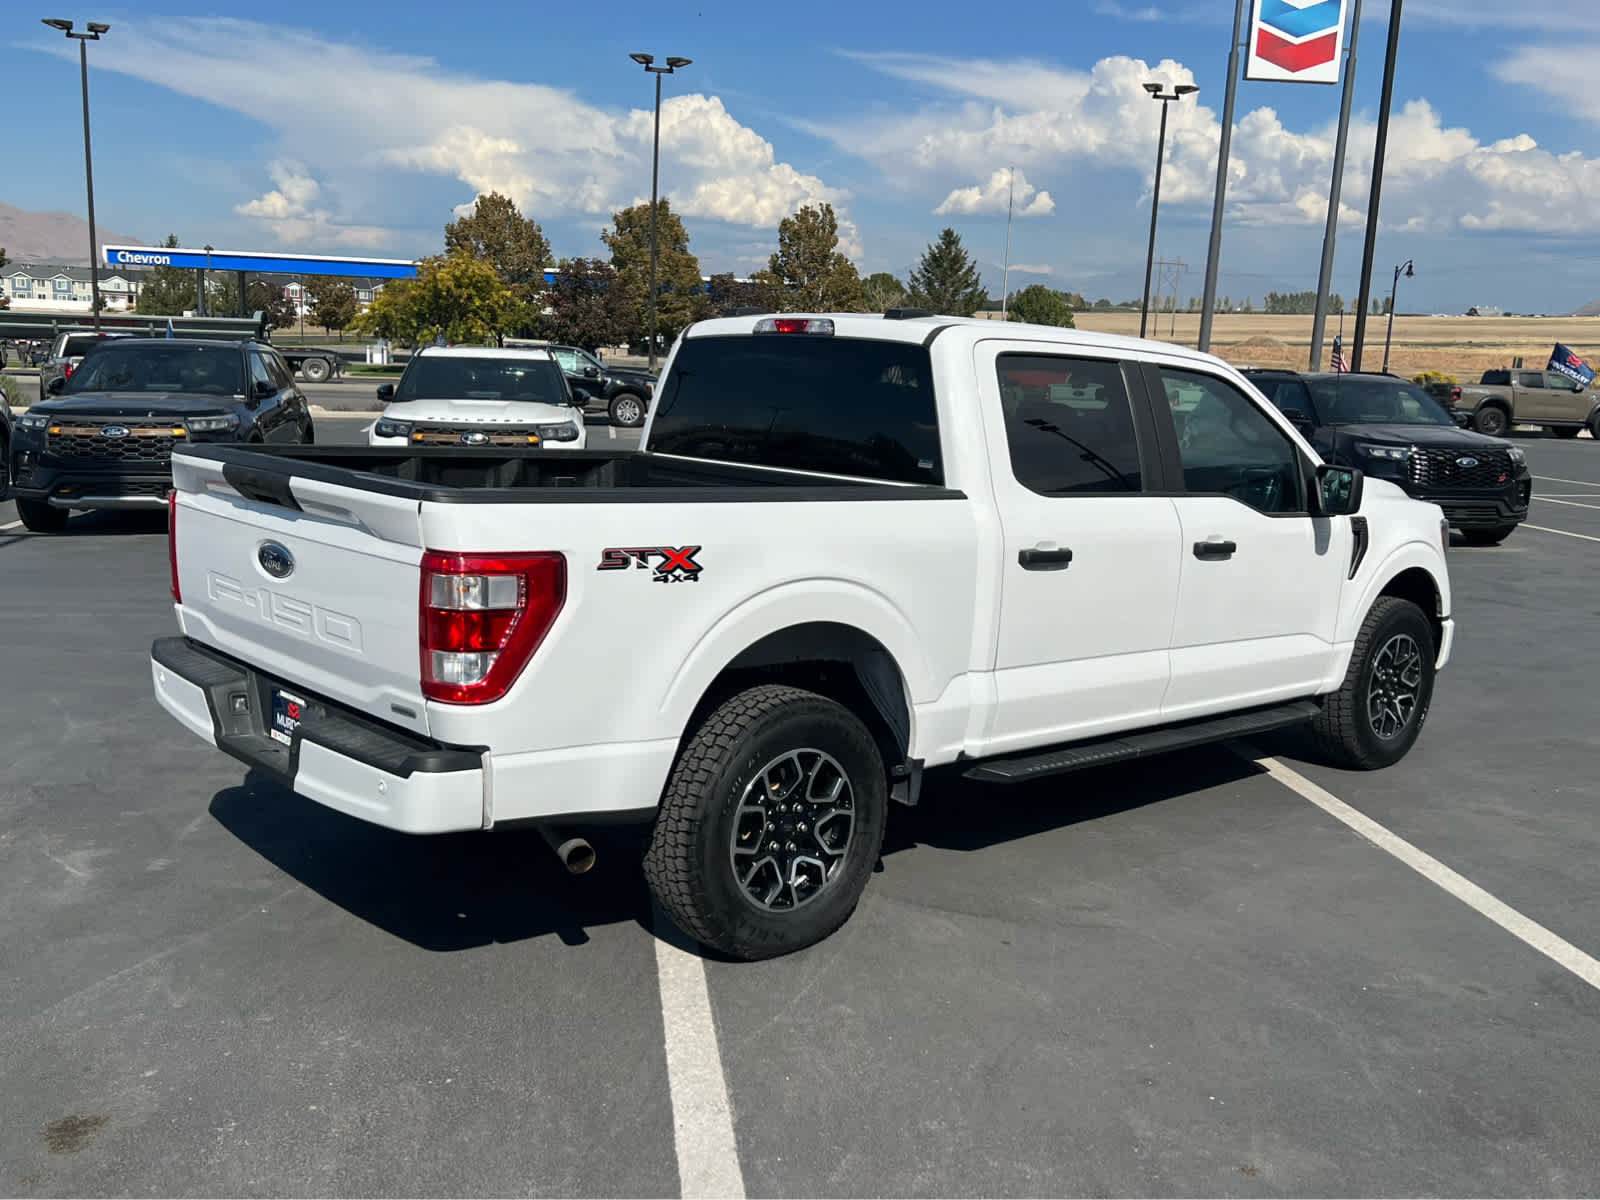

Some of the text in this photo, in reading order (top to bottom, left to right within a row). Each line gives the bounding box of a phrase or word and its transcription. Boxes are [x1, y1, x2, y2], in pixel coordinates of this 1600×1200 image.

[117, 251, 171, 265] Chevron
[597, 545, 704, 574] STX
[207, 570, 365, 654] F-150
